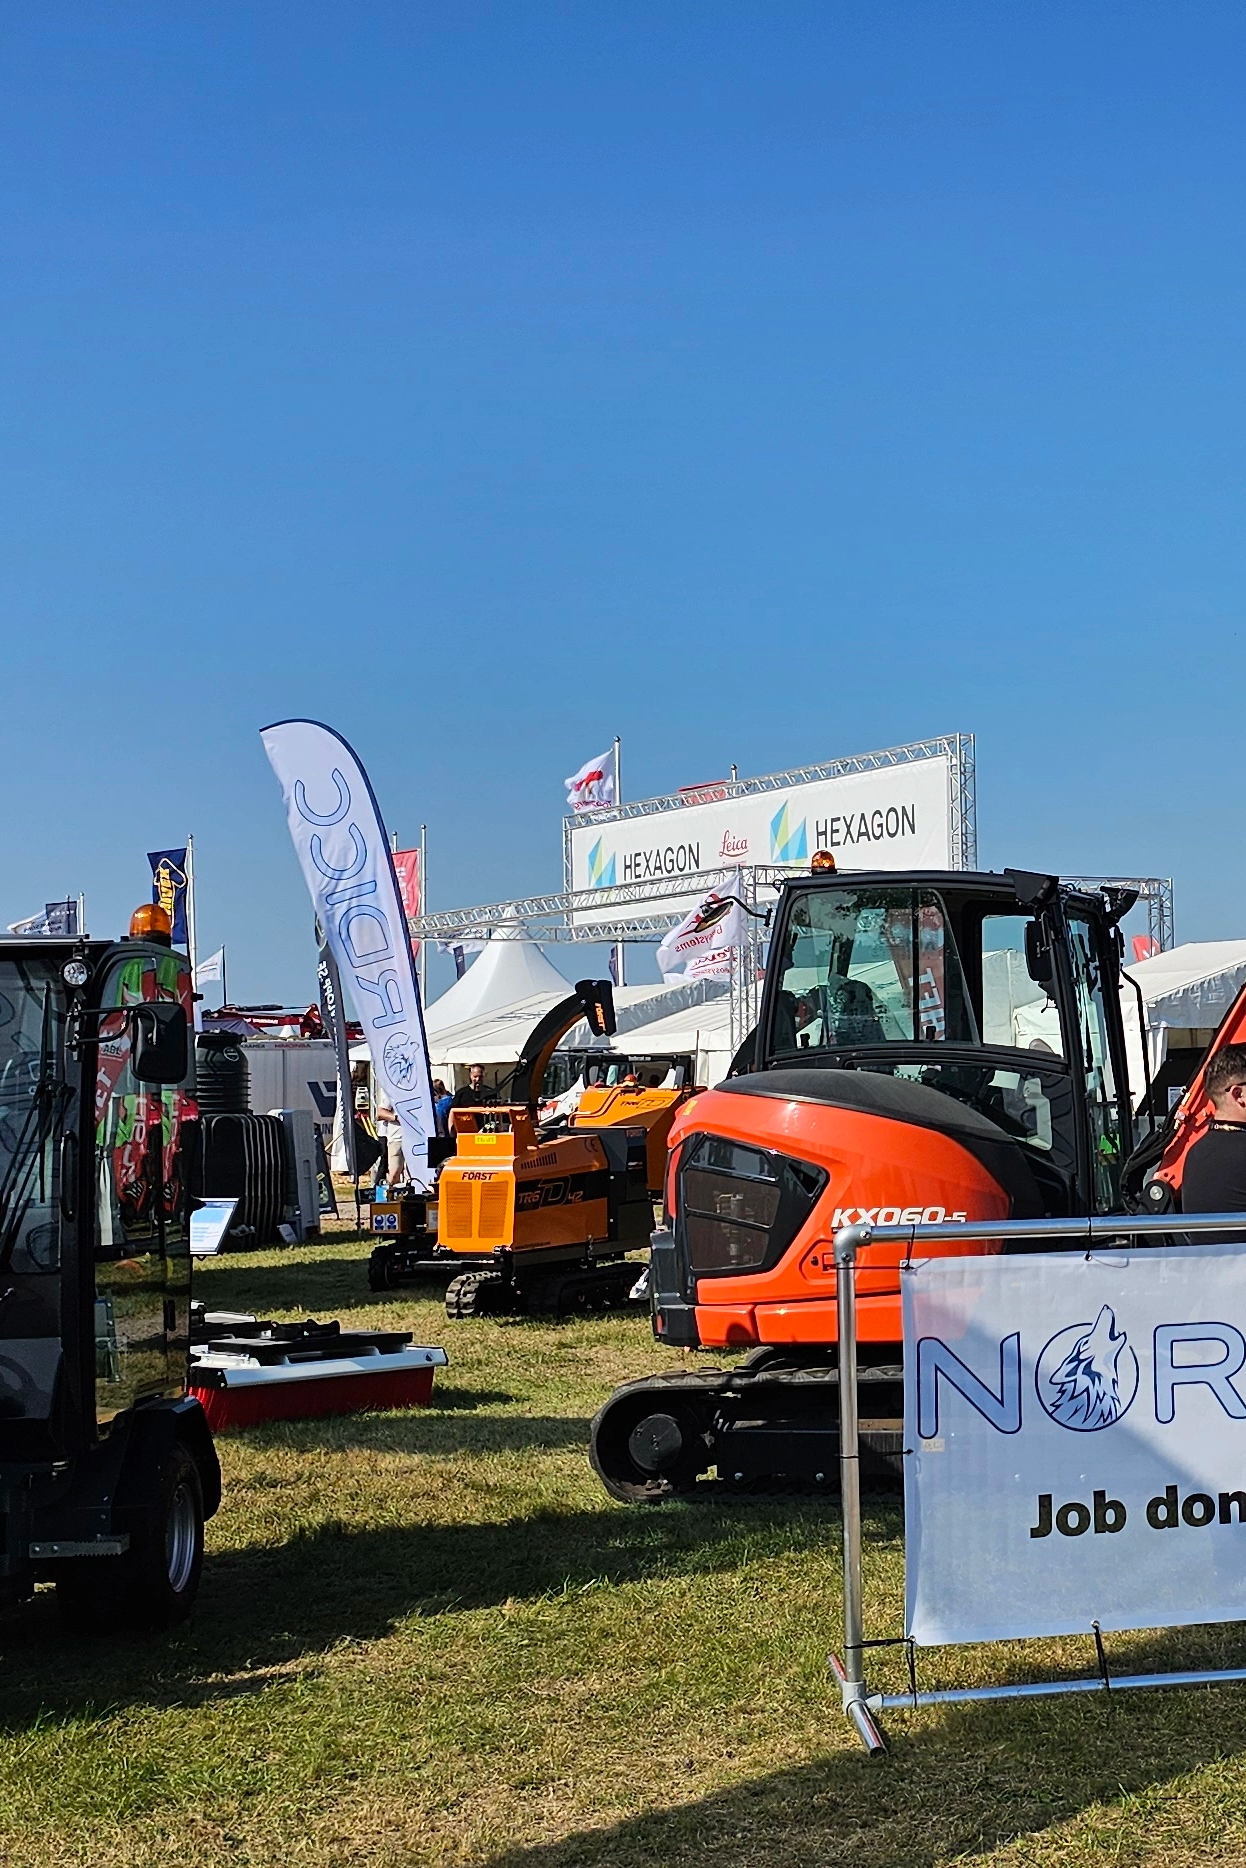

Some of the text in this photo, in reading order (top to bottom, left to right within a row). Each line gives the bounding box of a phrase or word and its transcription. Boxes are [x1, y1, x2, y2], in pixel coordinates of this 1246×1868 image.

[717, 829, 750, 858] Leica
[815, 803, 916, 849] HEXAGON
[623, 841, 701, 881] HEXAGON
[1029, 1490, 1127, 1539] Job
